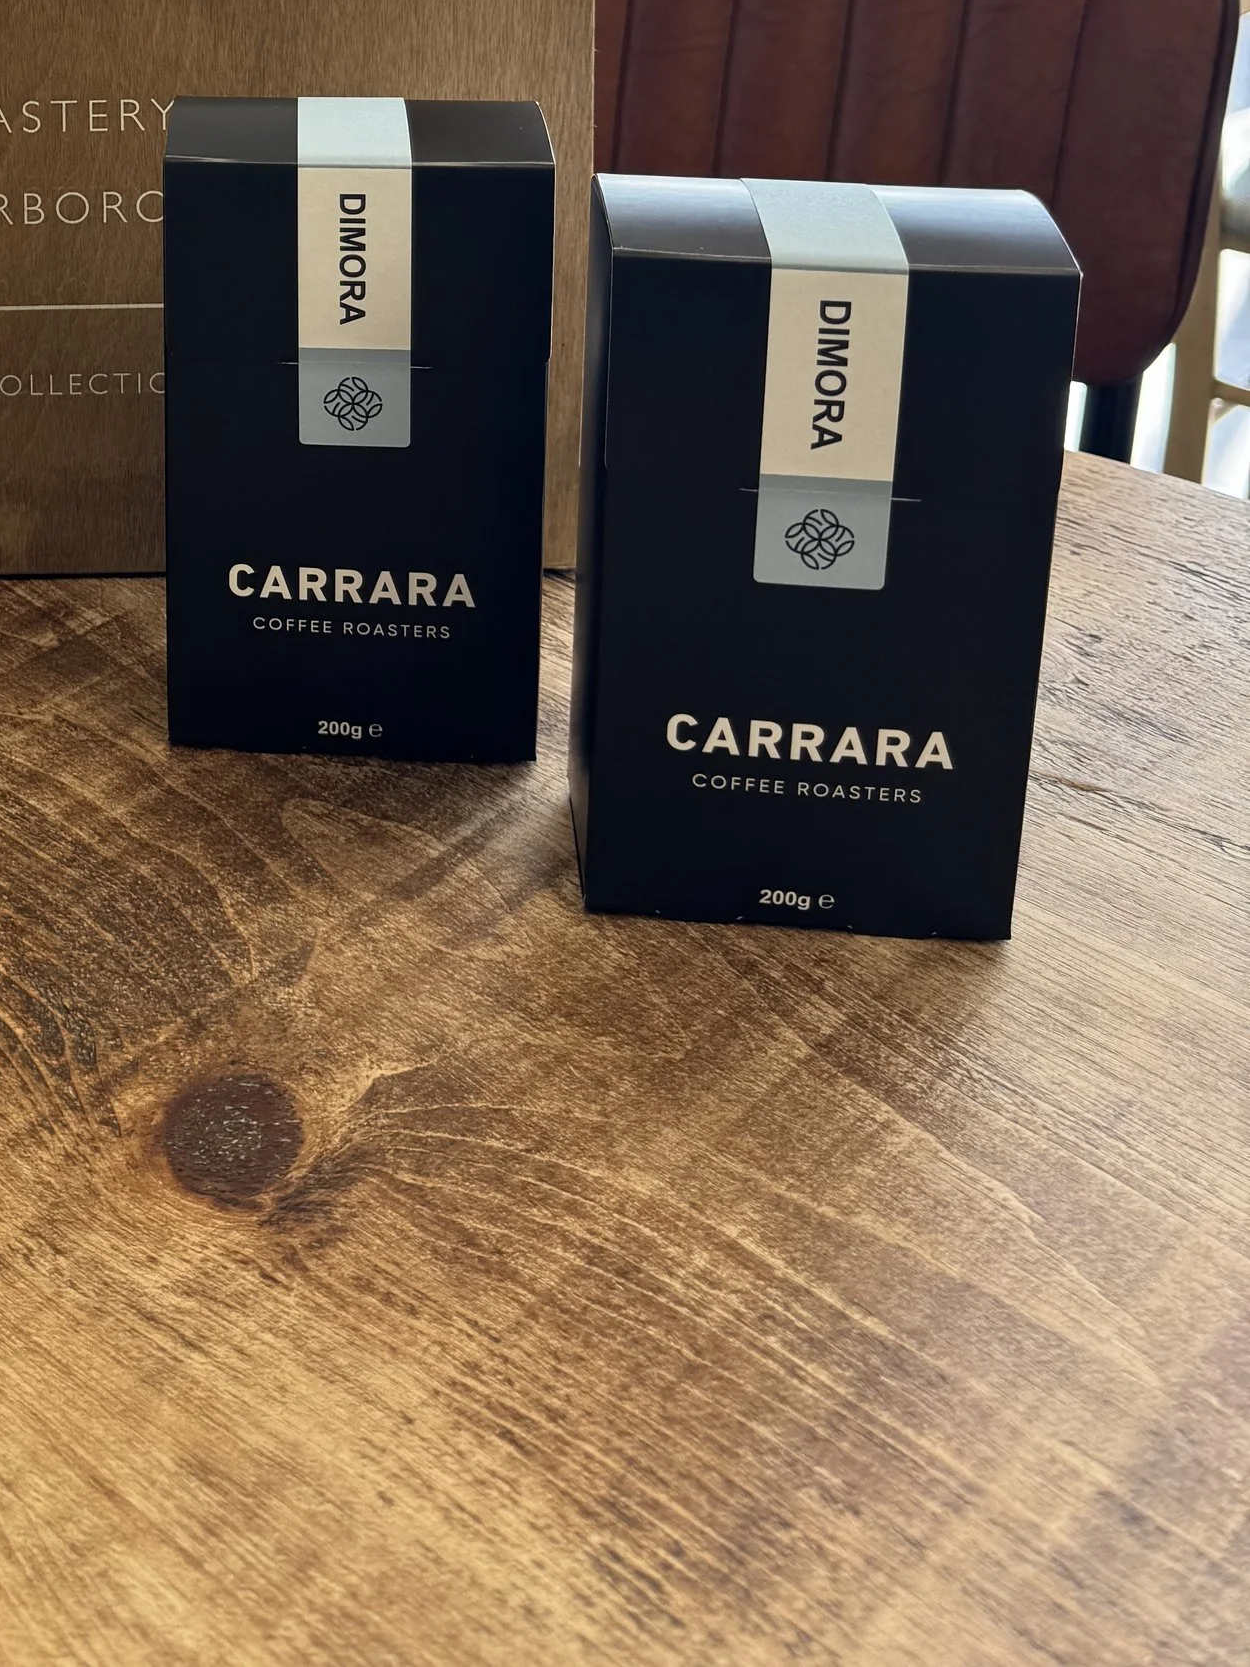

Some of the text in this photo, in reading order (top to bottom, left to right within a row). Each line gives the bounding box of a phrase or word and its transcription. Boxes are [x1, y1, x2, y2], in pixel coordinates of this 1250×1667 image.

[338, 191, 367, 326] DIMORA
[810, 299, 852, 451] DIMORA
[228, 563, 477, 608] CARRARA
[252, 616, 451, 639] COFFEE ROASTERS
[317, 720, 363, 740] 200g
[666, 713, 955, 771] CARRARA
[691, 773, 922, 804] COFFEE ROASTERS
[758, 888, 811, 911] 200g
